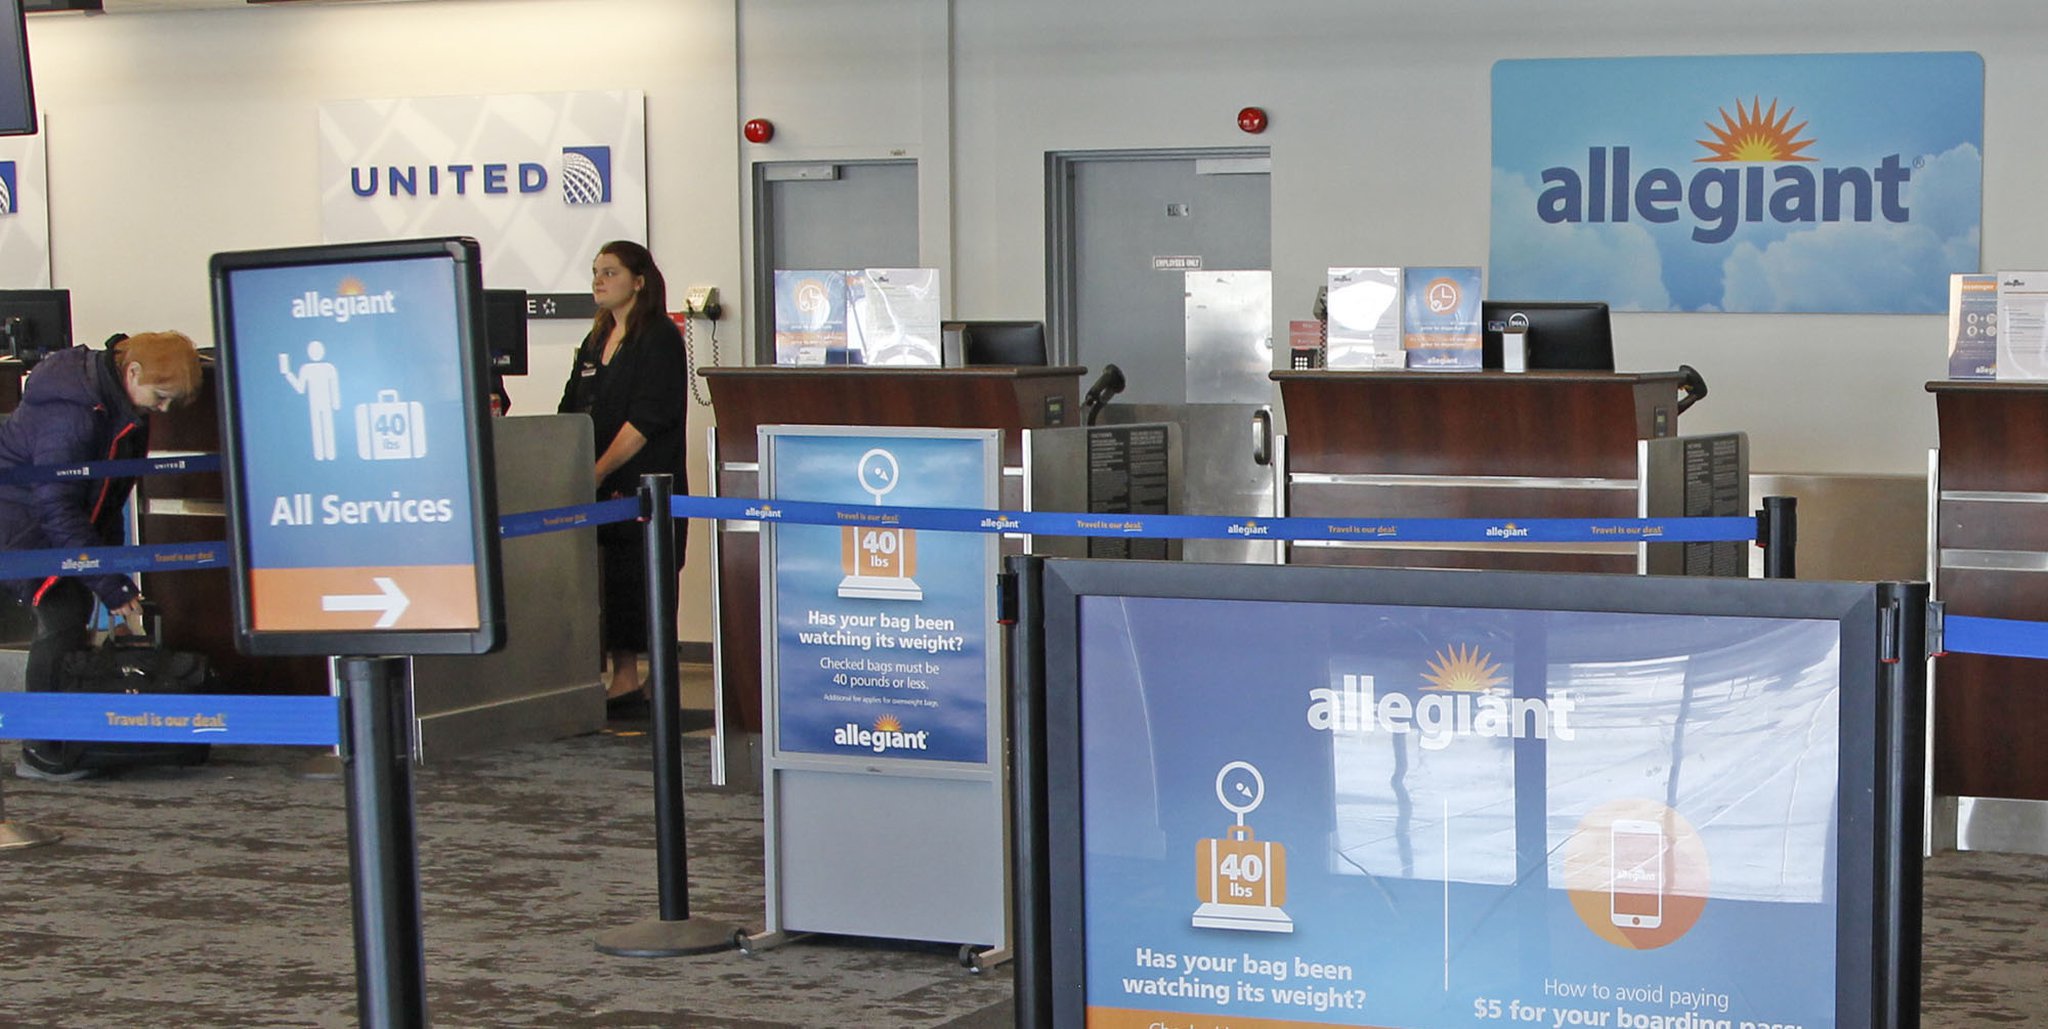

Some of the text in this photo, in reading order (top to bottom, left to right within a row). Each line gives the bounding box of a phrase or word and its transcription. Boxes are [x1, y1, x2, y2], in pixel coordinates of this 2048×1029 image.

[350, 162, 549, 197] UNITED
[1155, 258, 1199, 268] EMPLOYEES ONLY
[292, 290, 396, 323] allegiant
[375, 413, 406, 436] 40
[383, 437, 400, 450] lbs
[270, 491, 454, 526] All Services
[745, 508, 781, 519] allegiant
[981, 517, 1020, 529] allegiant
[1076, 520, 1100, 529] Travel
[1101, 521, 1108, 529] is
[1227, 525, 1268, 536] allegiant
[1328, 525, 1352, 533] Travel
[1591, 526, 1616, 534] Travel
[1618, 526, 1626, 534] is
[1486, 526, 1528, 539] allegiant
[862, 531, 897, 555] 40
[61, 559, 100, 571] allegiant
[870, 555, 889, 568] lbs
[808, 611, 954, 632] Has your bag been
[799, 631, 964, 653] watching its weight?
[819, 657, 940, 675] Checked bags must be
[833, 673, 929, 690] 40 pounds or less.
[105, 711, 147, 726] Travel
[150, 712, 161, 726] is
[164, 715, 189, 726] our
[834, 723, 927, 752] allegiant
[1220, 853, 1263, 883] 40
[1229, 882, 1253, 898] lbs
[1136, 948, 1352, 981] Has your bag been
[1122, 976, 1367, 1012] watching its weight?
[1544, 978, 1729, 1013] How to avoid paying
[1474, 998, 1502, 1019] $5
[1508, 999, 1546, 1022] for
[1553, 1005, 1610, 1028] your
[1617, 1007, 1731, 1029] boarding
